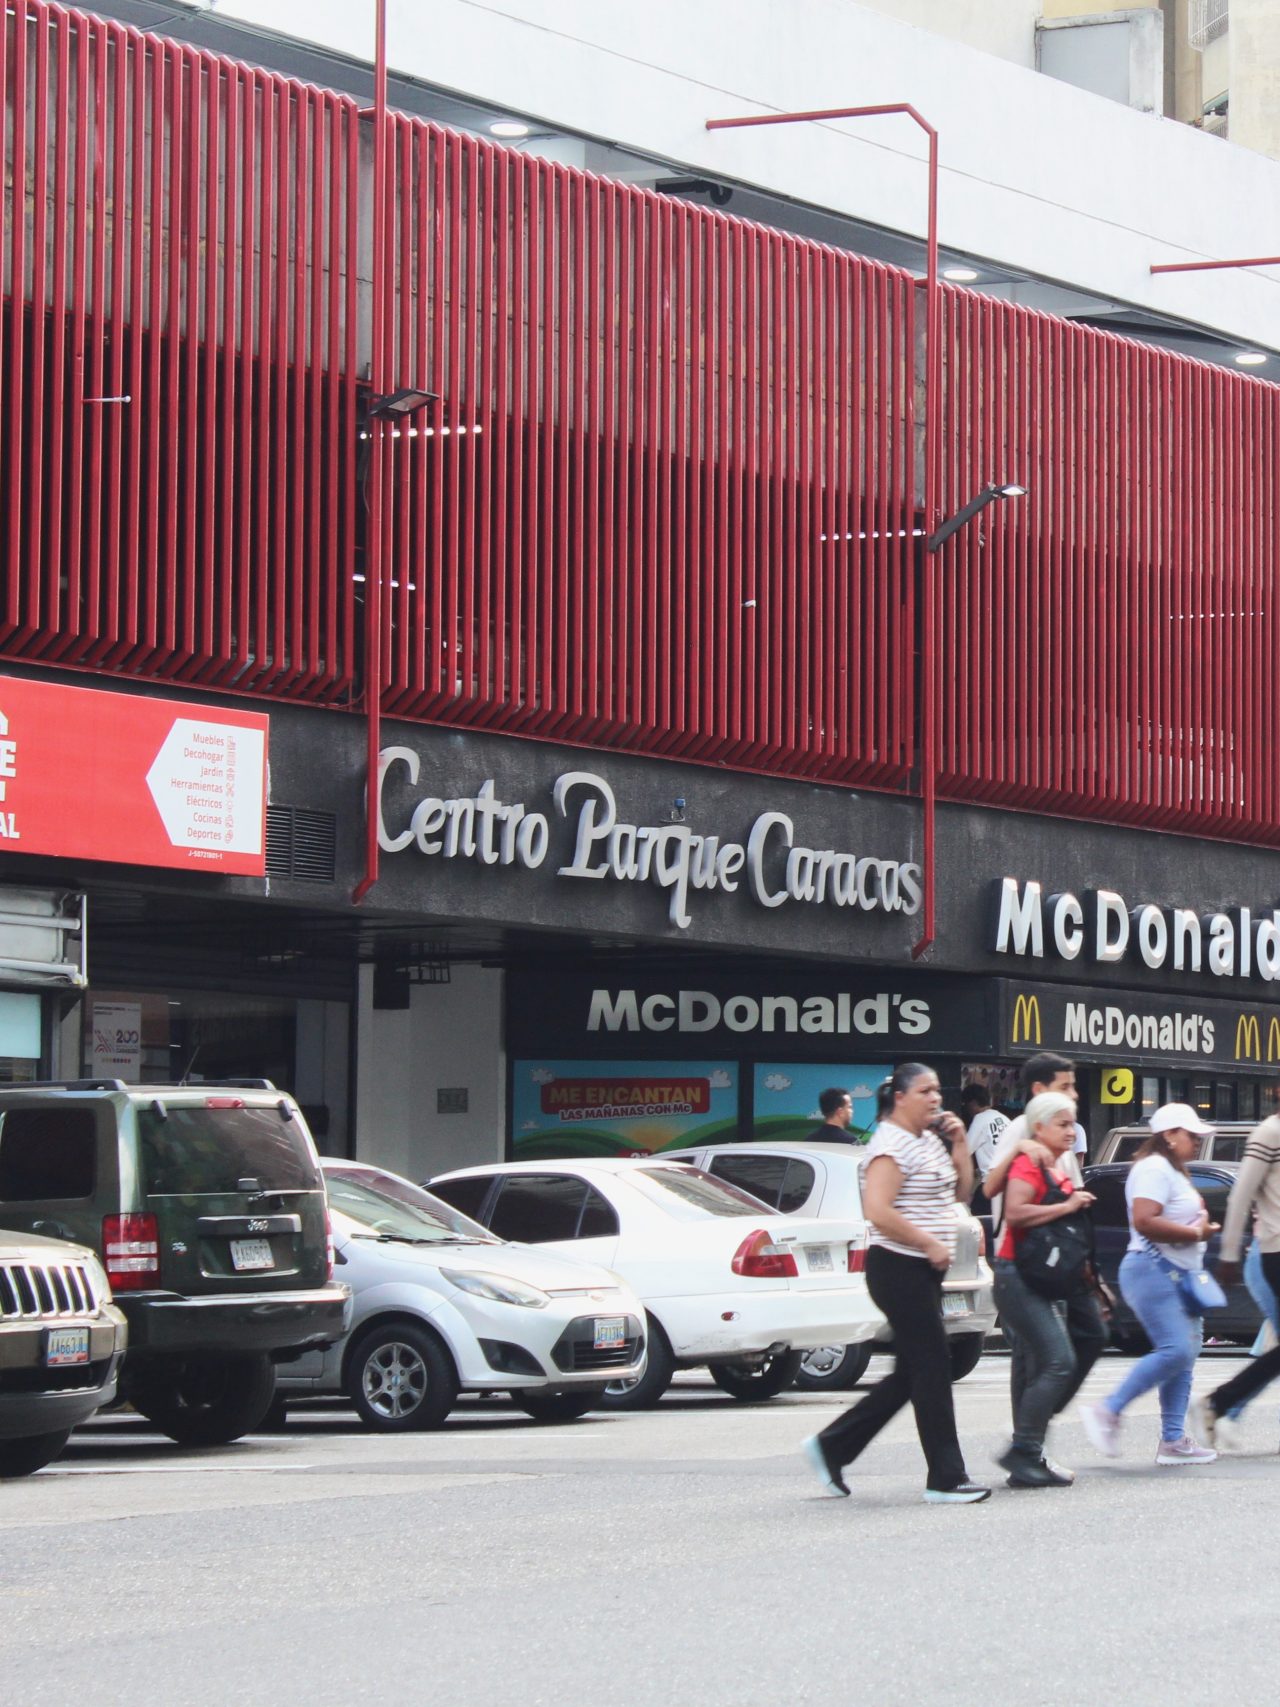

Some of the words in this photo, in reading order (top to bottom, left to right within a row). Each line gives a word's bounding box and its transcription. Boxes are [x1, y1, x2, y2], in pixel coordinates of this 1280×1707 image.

[193, 733, 225, 747] Muebles
[184, 748, 224, 763] Decohogar
[171, 778, 224, 794] Herramientas
[193, 812, 223, 825] Cocinas
[187, 827, 222, 841] Deportes
[366, 745, 550, 869] Centro
[552, 770, 745, 929] Parque
[747, 811, 922, 915] Caracas
[586, 989, 932, 1035] McDonald's
[1063, 1002, 1215, 1055] McDonald's
[550, 1086, 581, 1104] ME
[585, 1086, 700, 1104] ENCANTAN
[560, 1109, 583, 1121] LAS
[584, 1104, 645, 1119] MAÑANAS
[646, 1103, 672, 1115] CON
[673, 1103, 692, 1114] Mc
